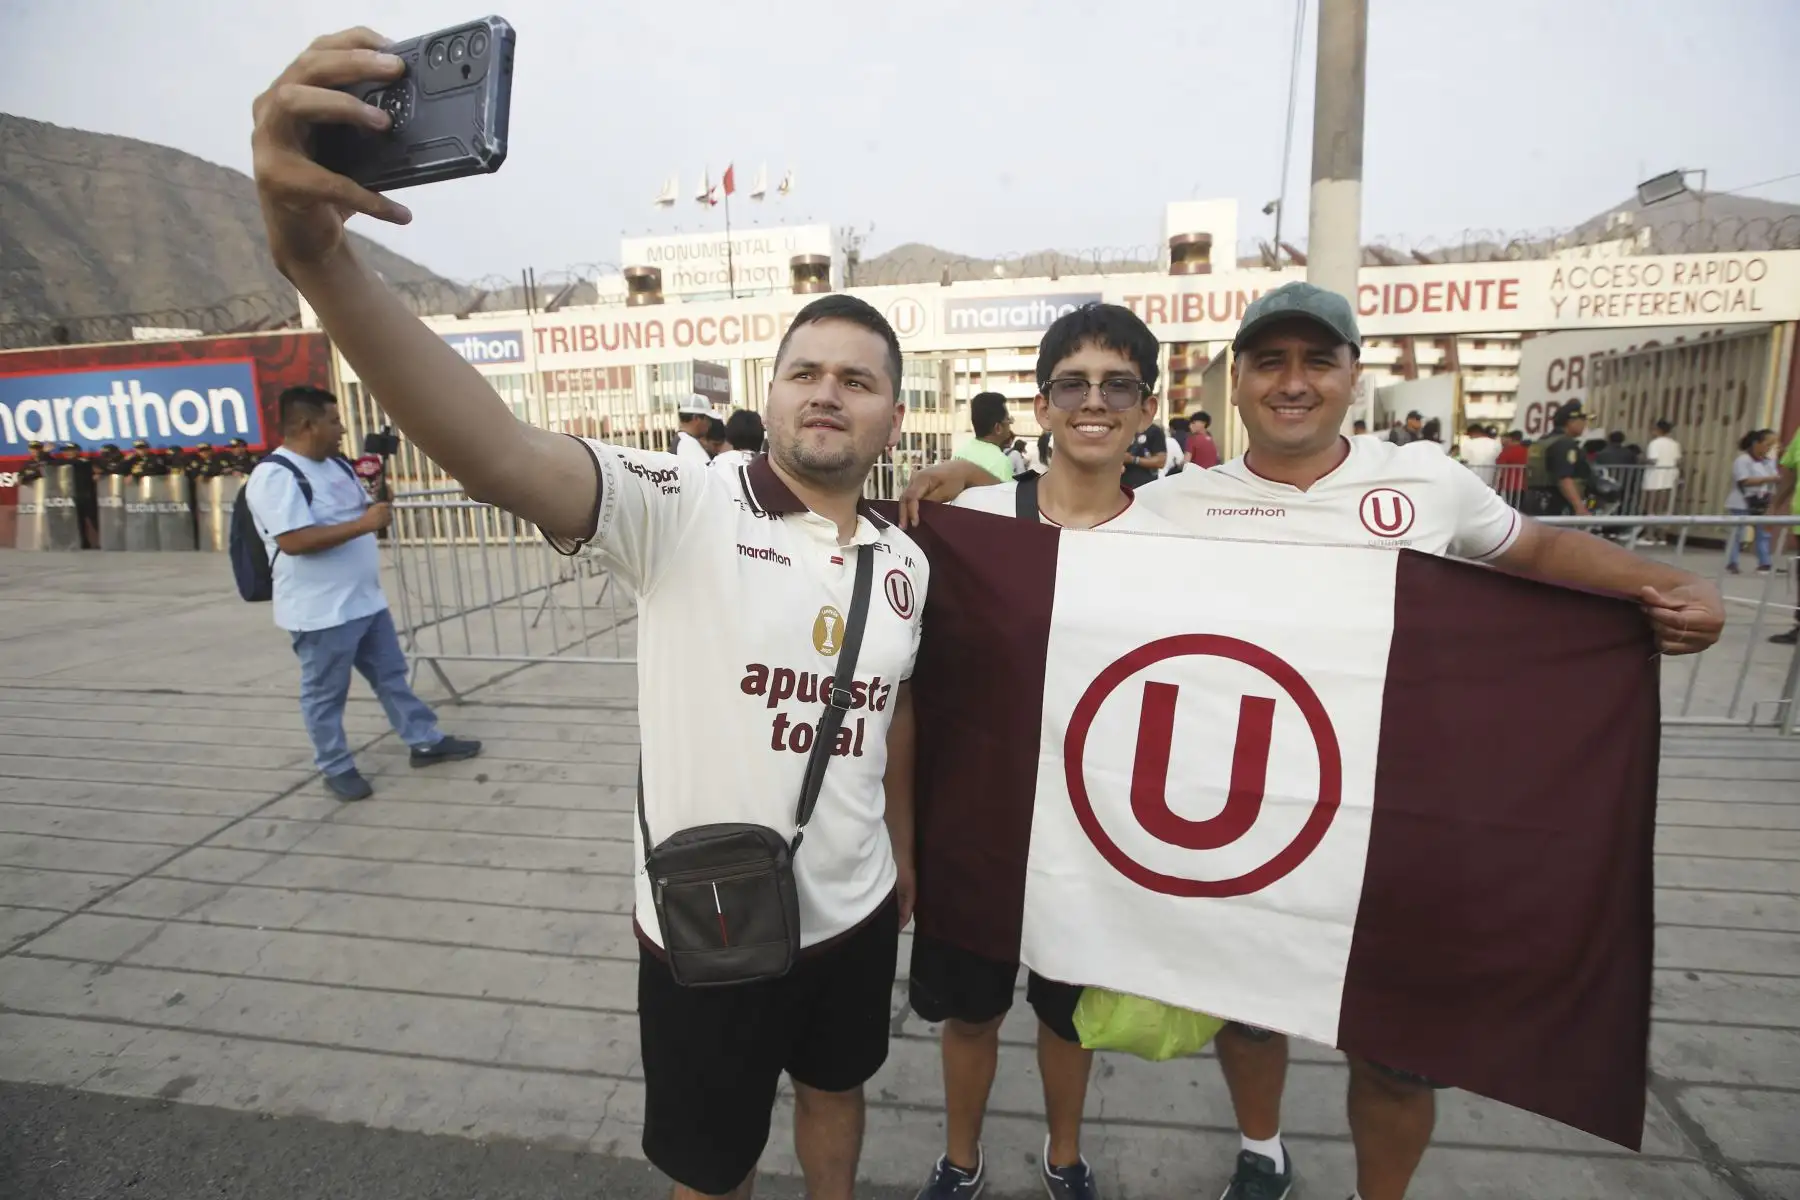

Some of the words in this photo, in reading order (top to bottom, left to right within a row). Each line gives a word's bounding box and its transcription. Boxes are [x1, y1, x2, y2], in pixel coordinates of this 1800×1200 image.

[647, 239, 776, 262] MONUMENTAL
[672, 262, 780, 287] marathon
[1550, 263, 1664, 291] ACCESO
[1673, 258, 1768, 286] RAPIDO
[951, 299, 1079, 328] maratho
[1123, 288, 1260, 324] TRIBUN
[1357, 279, 1520, 317] CIDENTE
[1551, 295, 1568, 319] Y
[1577, 289, 1763, 319] PREFERENCIAL
[533, 319, 665, 355] TRIBUNA
[673, 312, 796, 348] OCCIDE
[894, 305, 916, 334] U
[1206, 506, 1286, 517] marathon
[1371, 496, 1403, 532] U
[737, 543, 792, 568] marathon
[890, 577, 909, 613] U
[740, 663, 892, 712] apuesta
[771, 712, 865, 758] toal
[1130, 680, 1277, 851] U
